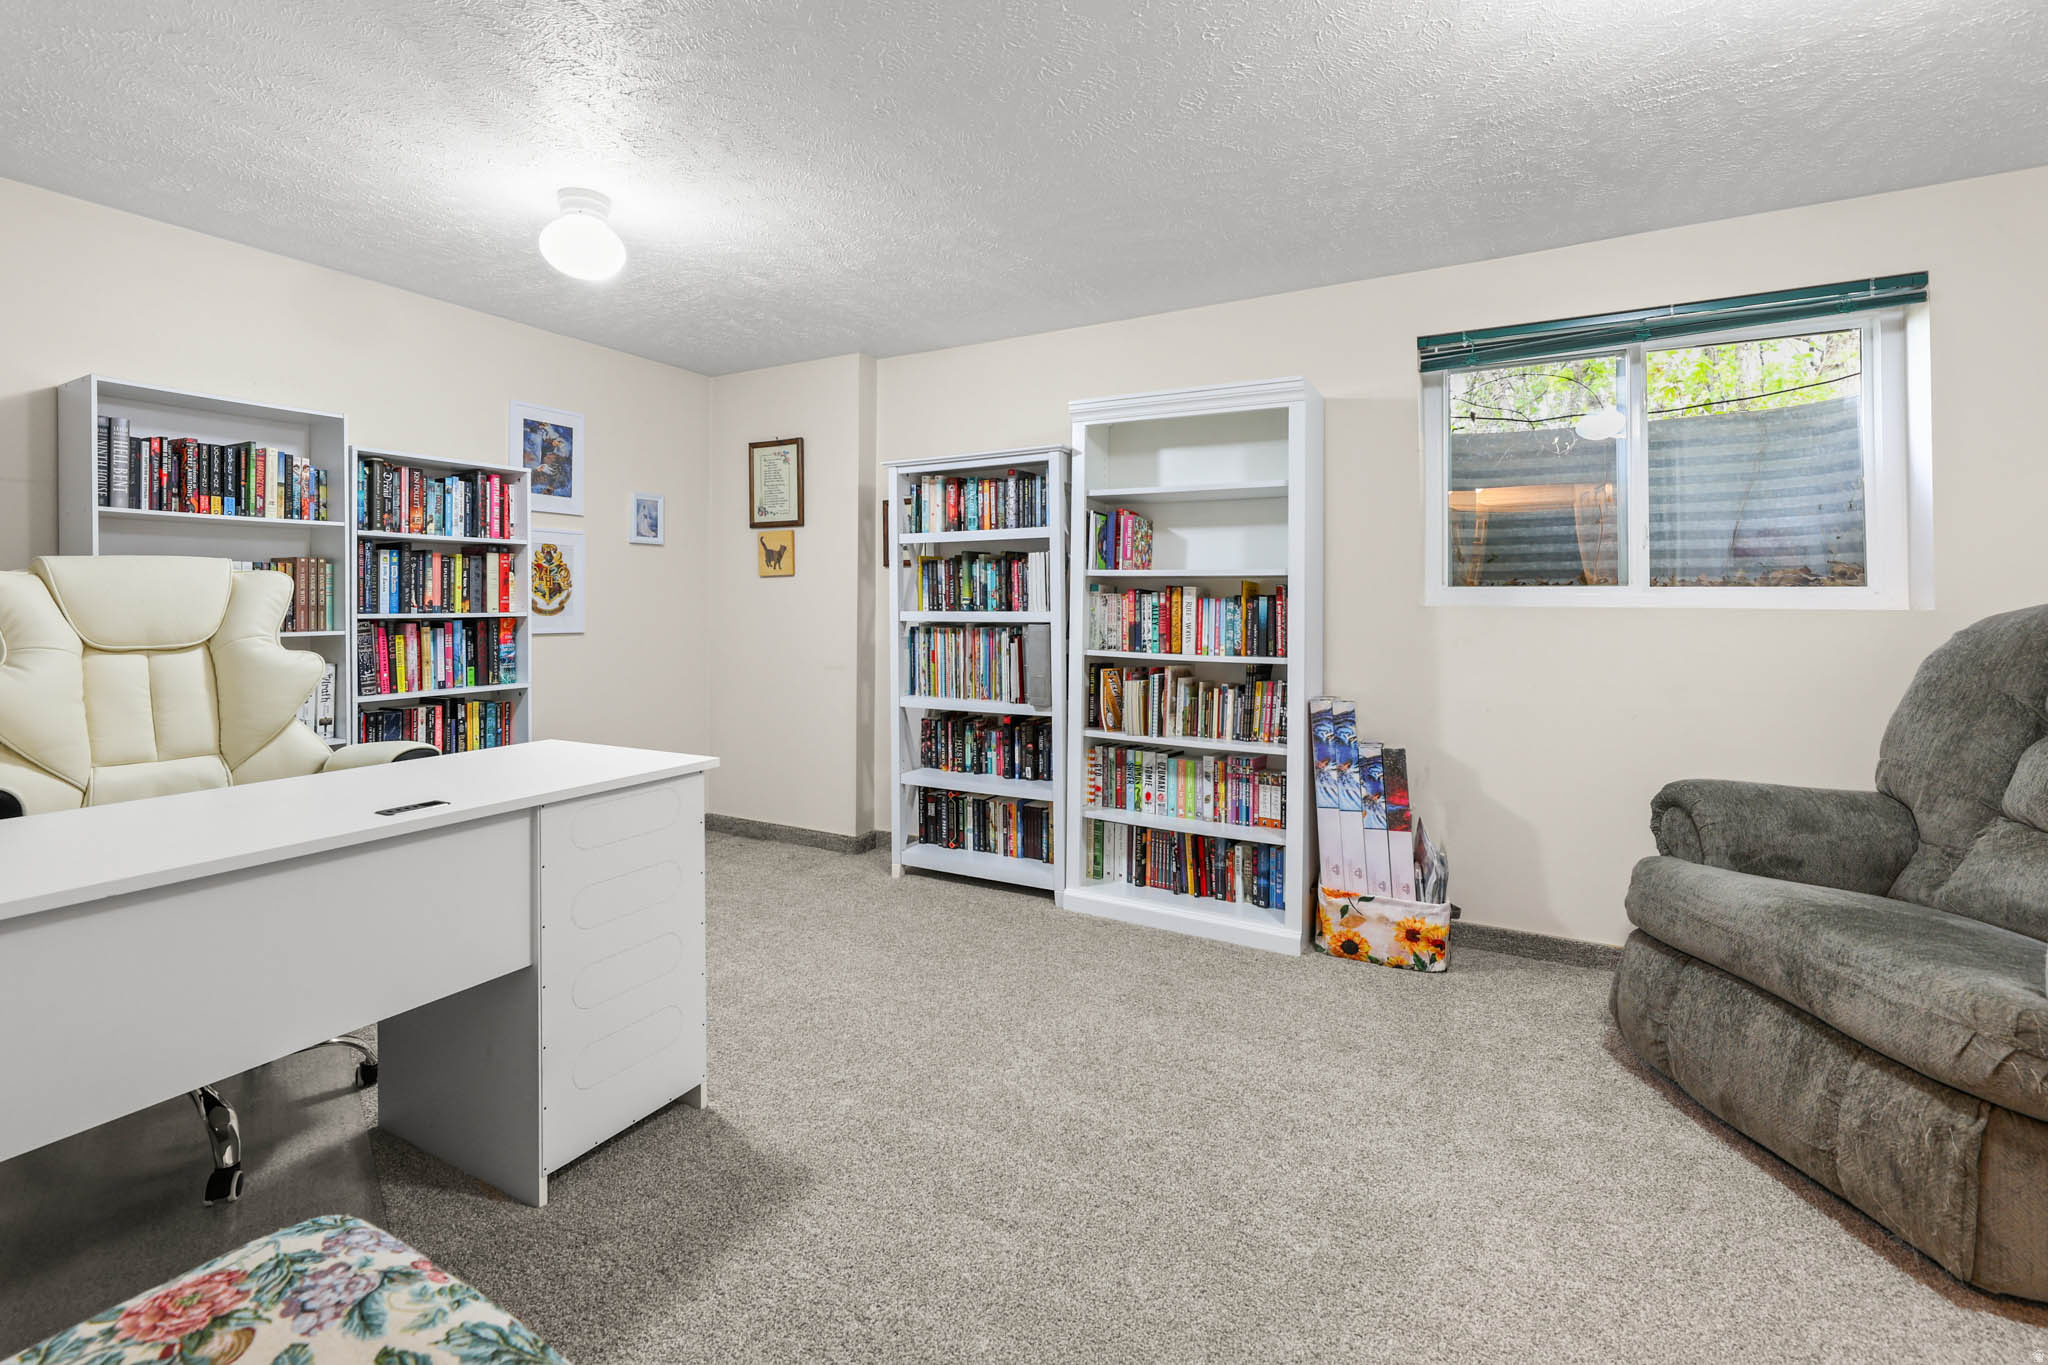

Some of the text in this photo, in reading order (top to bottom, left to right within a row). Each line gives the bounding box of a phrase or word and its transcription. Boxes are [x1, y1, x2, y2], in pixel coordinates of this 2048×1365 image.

[98, 440, 108, 496] NINTH HOUSE
[113, 440, 129, 493] HELL BENT
[1151, 605, 1159, 625] ALLEY
[1185, 602, 1193, 616] RULE
[1185, 622, 1193, 644] WOLVES
[1126, 762, 1135, 785] SHIVER
[1145, 766, 1153, 787] TOMIE
[1157, 761, 1166, 793] UZUMAKI
